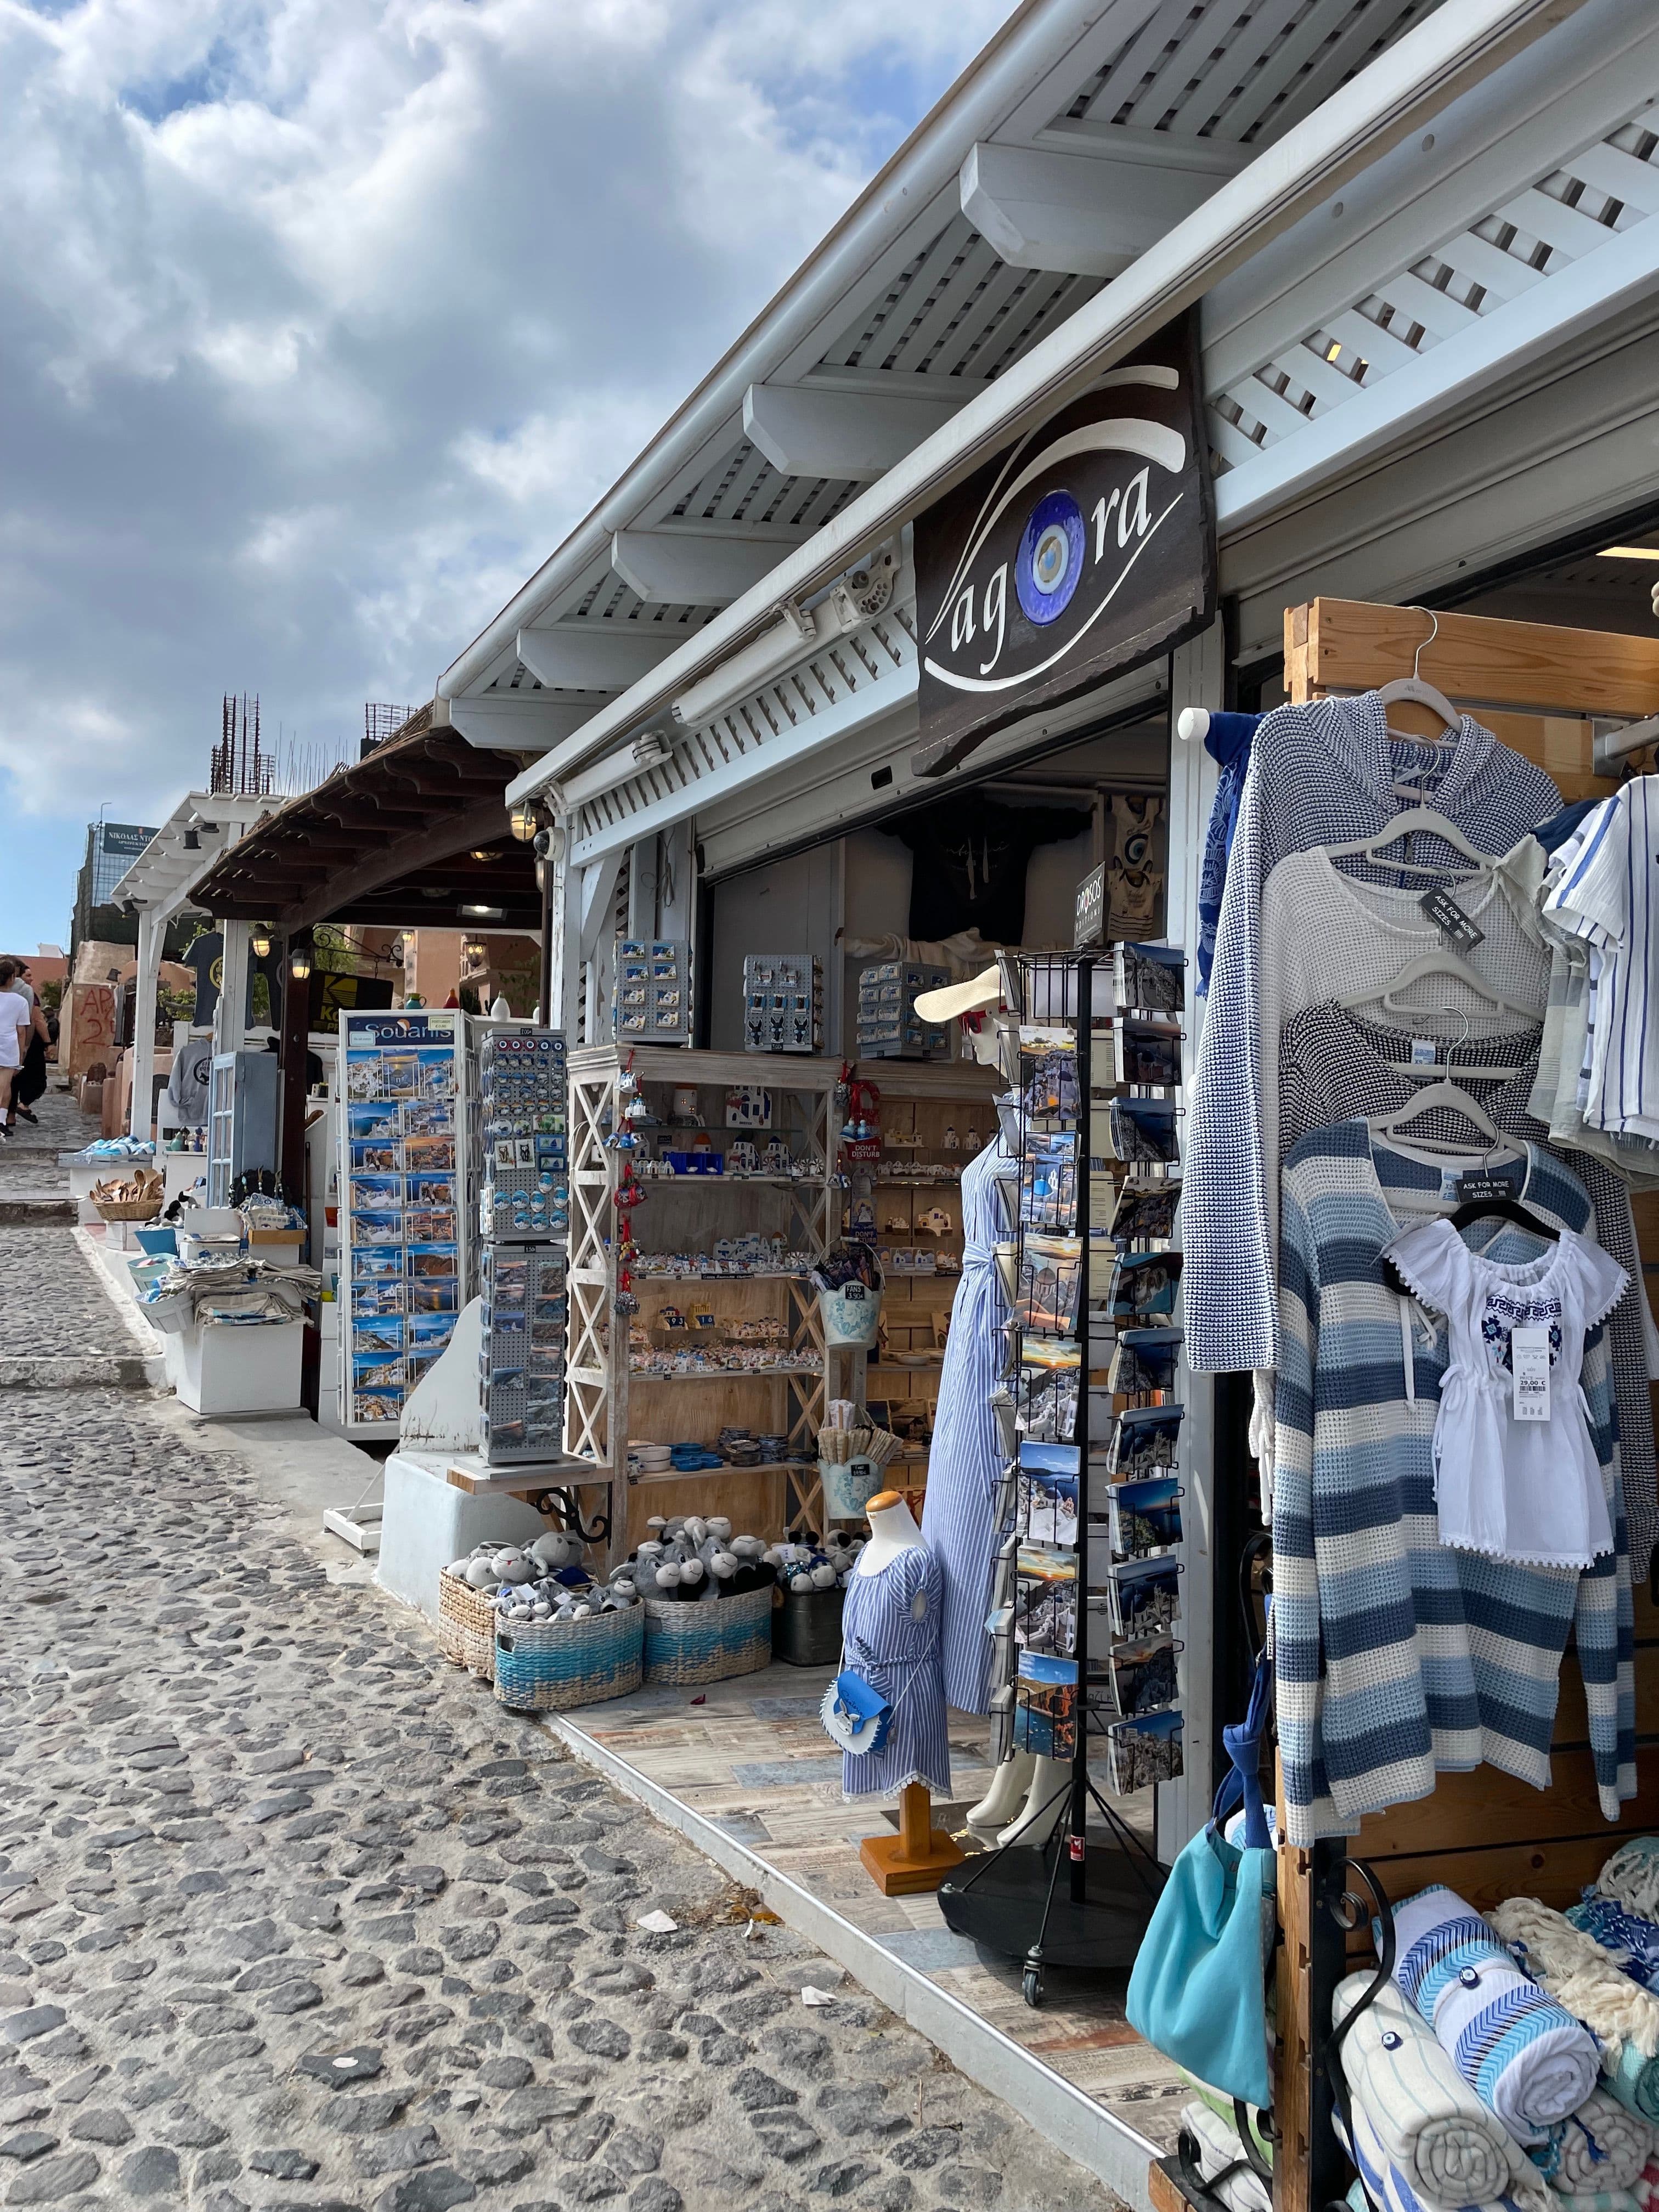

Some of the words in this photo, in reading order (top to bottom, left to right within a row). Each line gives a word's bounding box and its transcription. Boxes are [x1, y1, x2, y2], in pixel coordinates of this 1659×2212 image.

[1077, 872, 1102, 916] DROSOS
[1435, 895, 1449, 908] ASK
[1446, 906, 1460, 921] FOR
[1459, 920, 1478, 939] MORE
